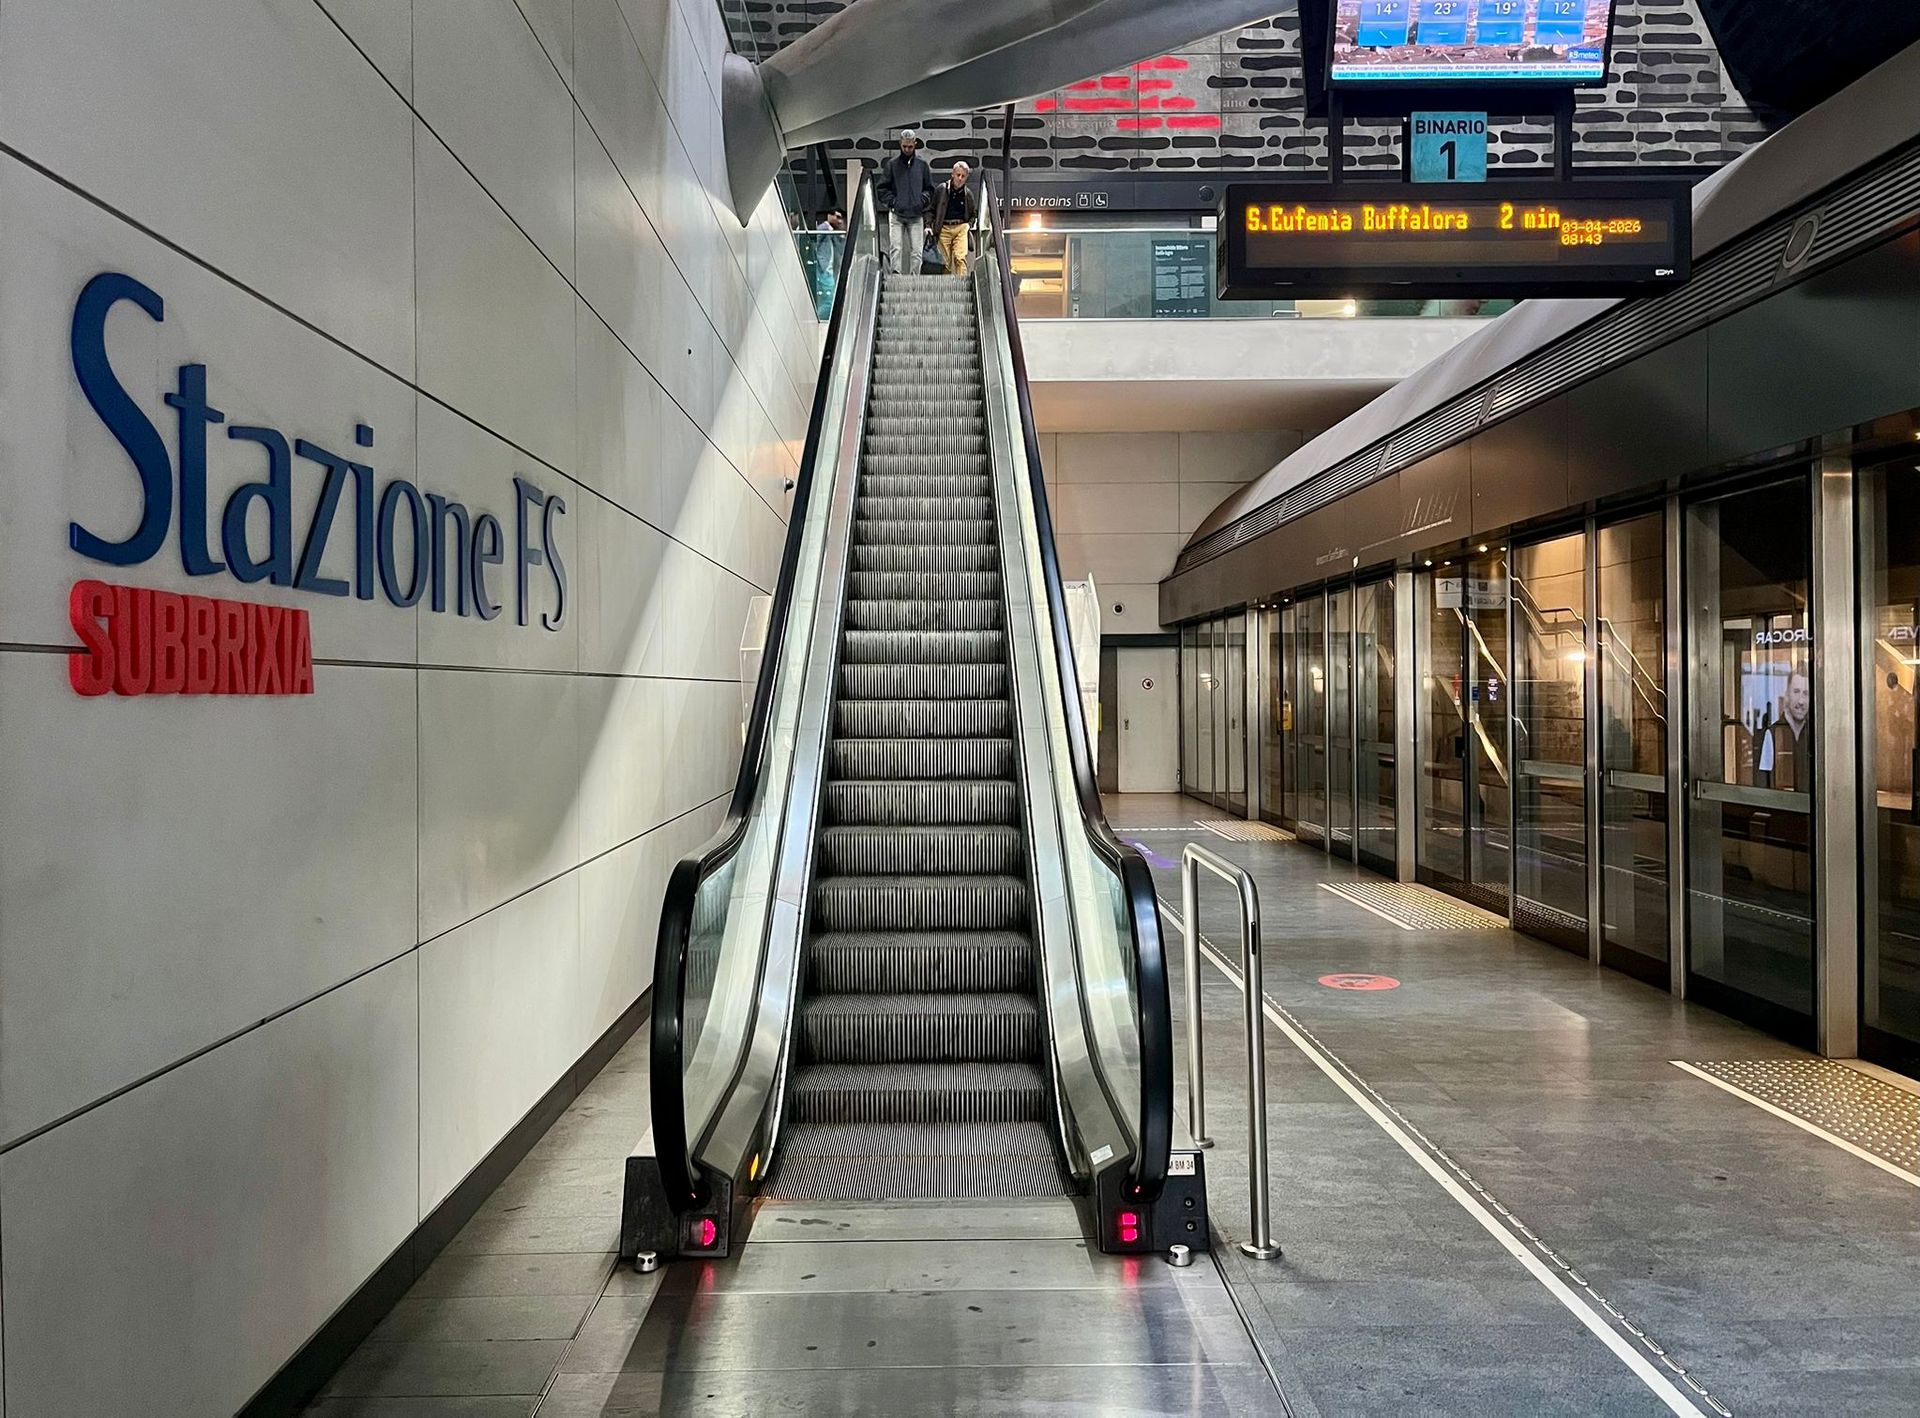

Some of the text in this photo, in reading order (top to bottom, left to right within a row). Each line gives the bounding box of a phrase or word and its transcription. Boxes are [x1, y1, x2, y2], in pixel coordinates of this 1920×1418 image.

[1376, 2, 1399, 15] 14°
[1434, 2, 1457, 15] 23°
[1495, 2, 1517, 15] 19°
[1554, 2, 1576, 15] 12°
[1415, 120, 1485, 134] BINARIO
[1439, 140, 1456, 180] 1
[1024, 196, 1038, 207] to
[1039, 195, 1072, 207] trains
[1246, 204, 1561, 232] S.Eufemia Buffalora 2 min
[1561, 220, 1642, 233] 09-04-2026
[1560, 233, 1603, 246] 08:43
[70, 272, 566, 632] Stazione FS
[69, 579, 315, 696] SUBBRIXIA
